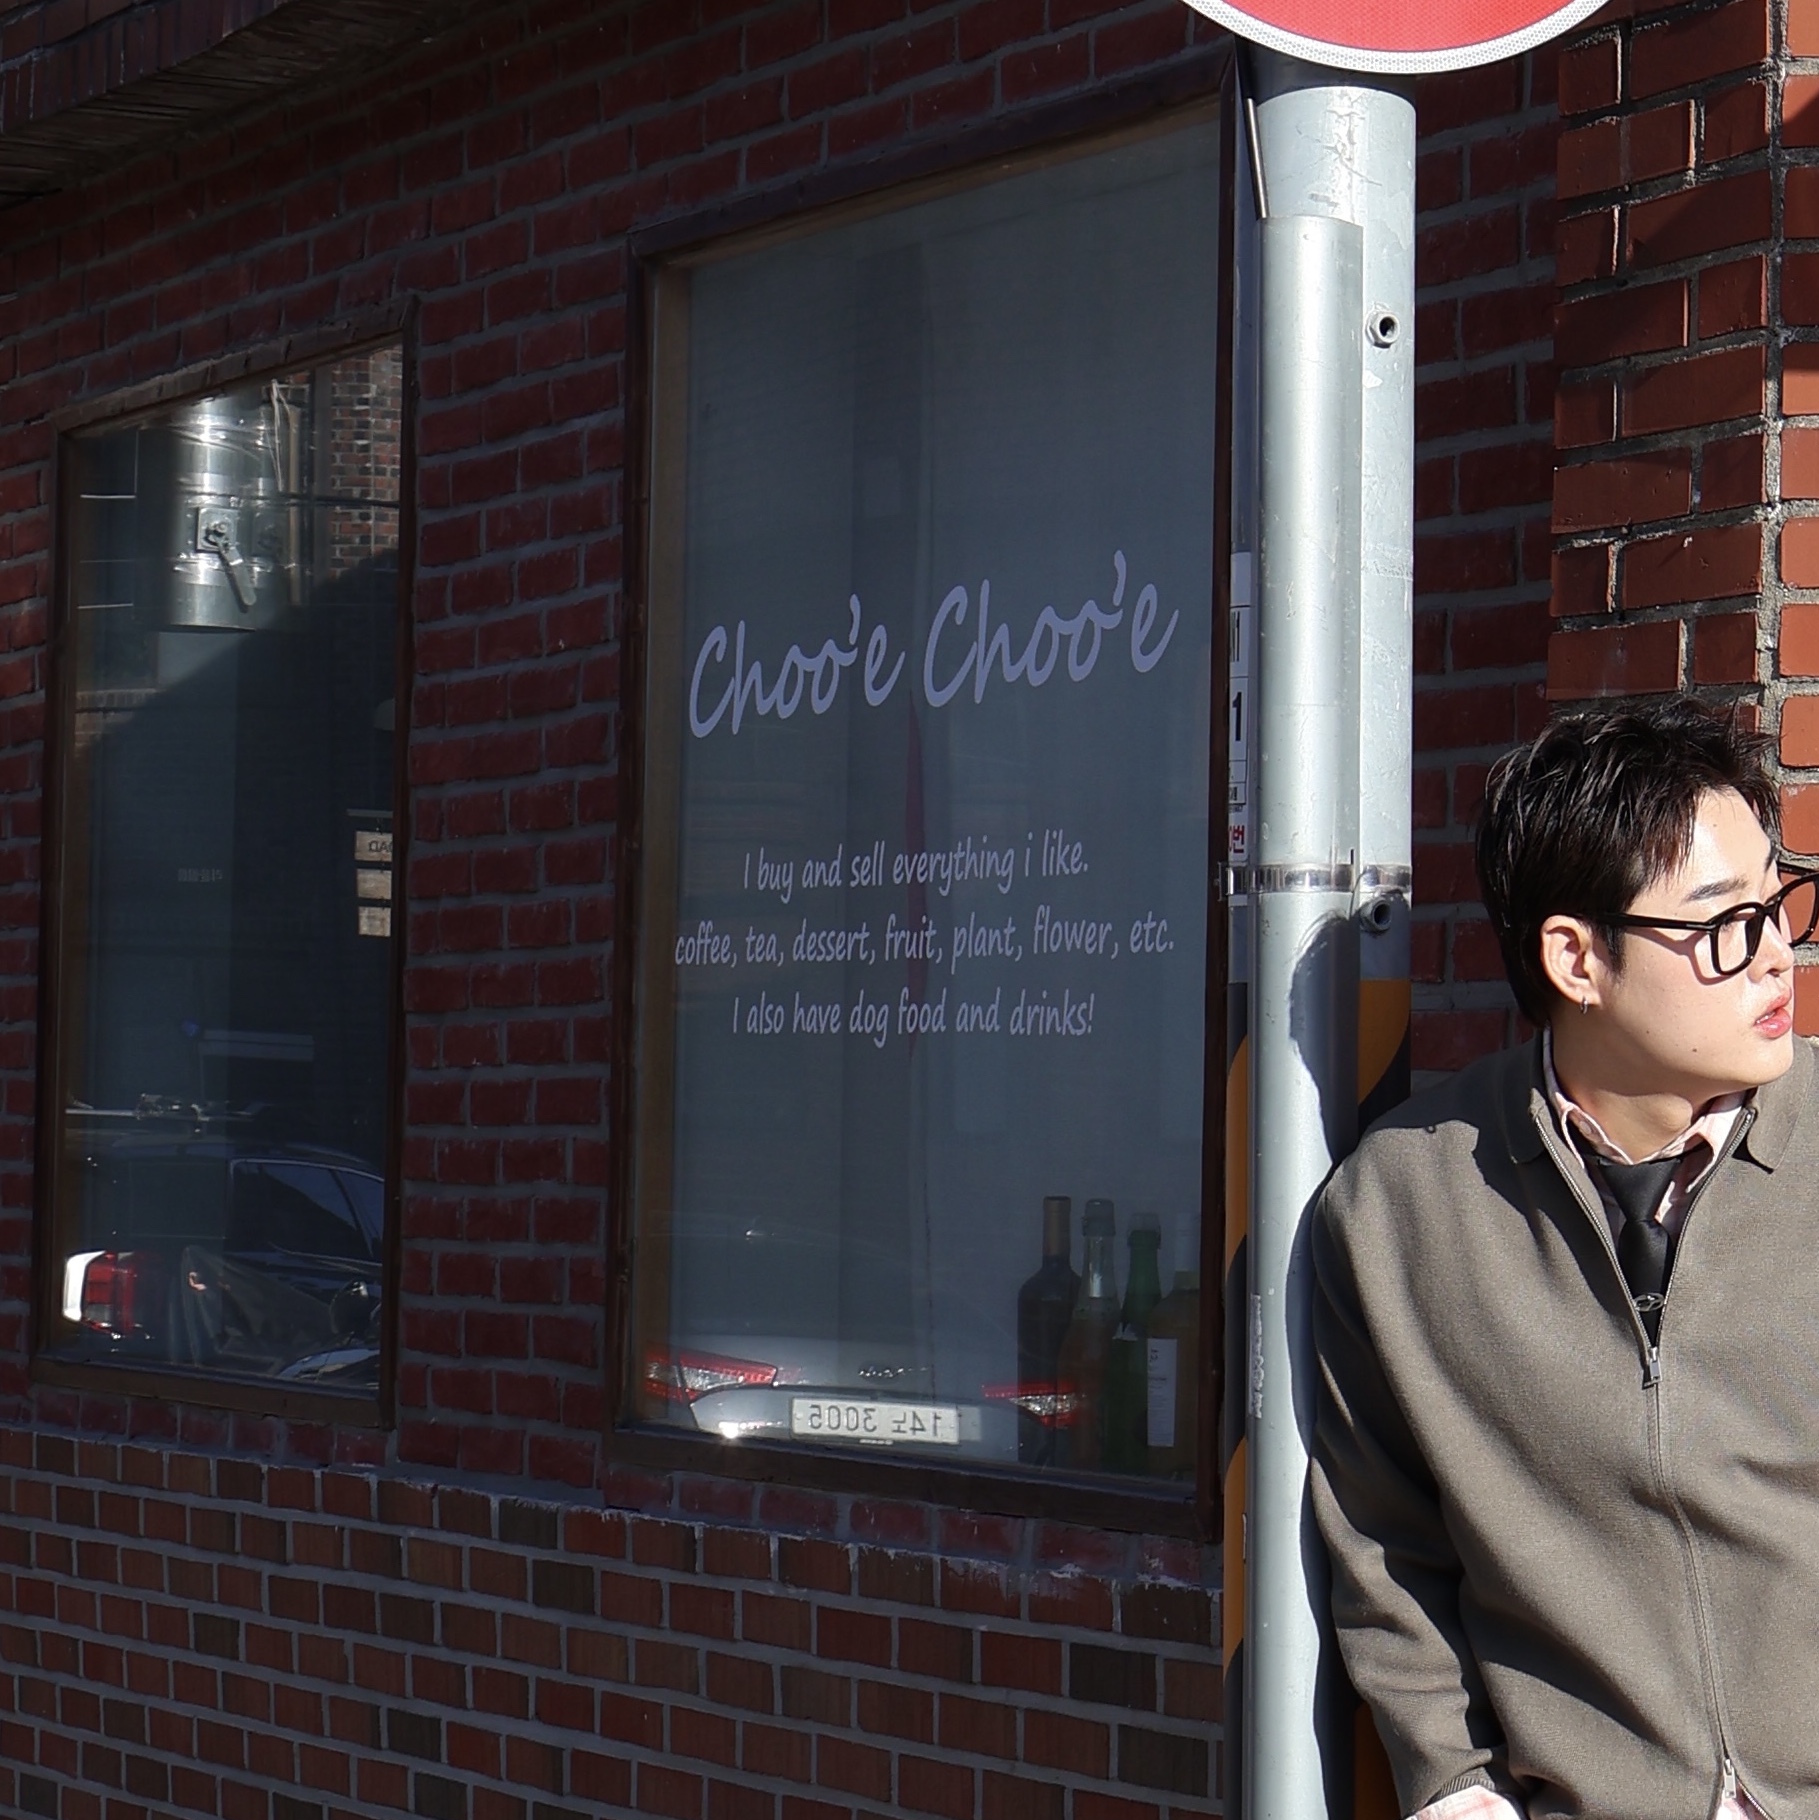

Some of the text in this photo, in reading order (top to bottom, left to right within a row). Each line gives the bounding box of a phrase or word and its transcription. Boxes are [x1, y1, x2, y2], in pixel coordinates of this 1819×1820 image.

[689, 549, 1180, 738] Choo'e Choo'e
[743, 828, 1089, 904] I buy and sell everything i like.
[674, 904, 1175, 976] coffee, tea, dessert, fruit, plant, flower, etc.
[732, 986, 1096, 1049] I also have dog food and drinks!
